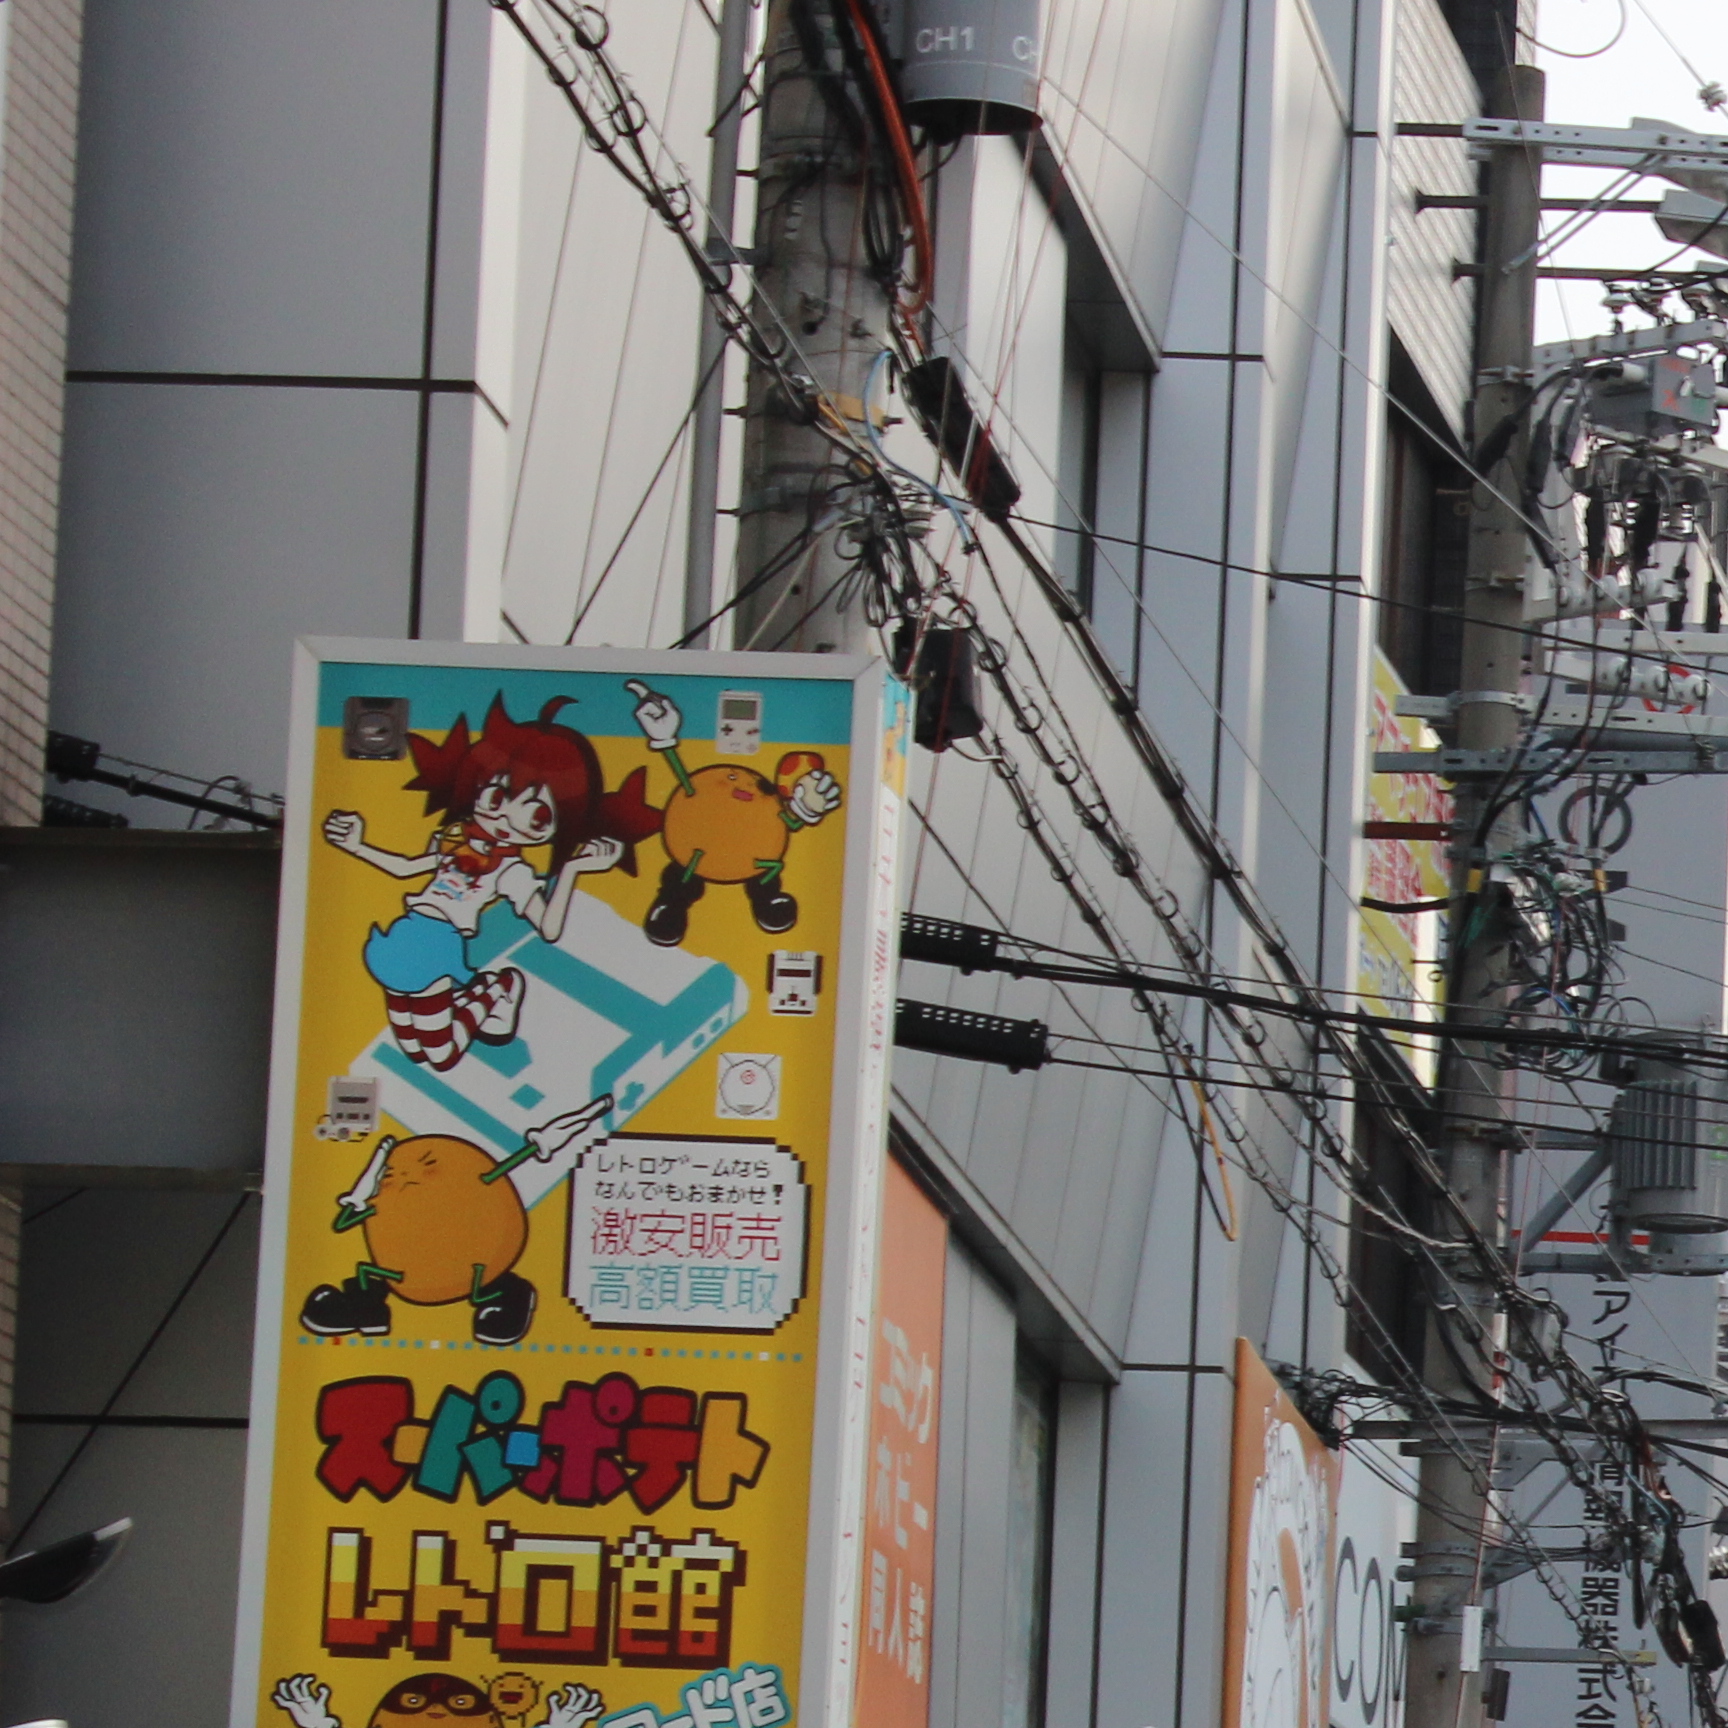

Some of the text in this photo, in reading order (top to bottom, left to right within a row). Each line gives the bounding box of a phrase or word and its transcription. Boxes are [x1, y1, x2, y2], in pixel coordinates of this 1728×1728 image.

[915, 26, 975, 54] CH1
[596, 1153, 771, 1180] レトロゲームなら
[590, 1207, 781, 1260] 激安販売
[588, 1261, 779, 1316] 高額買取
[321, 1520, 747, 1670] レトロ館
